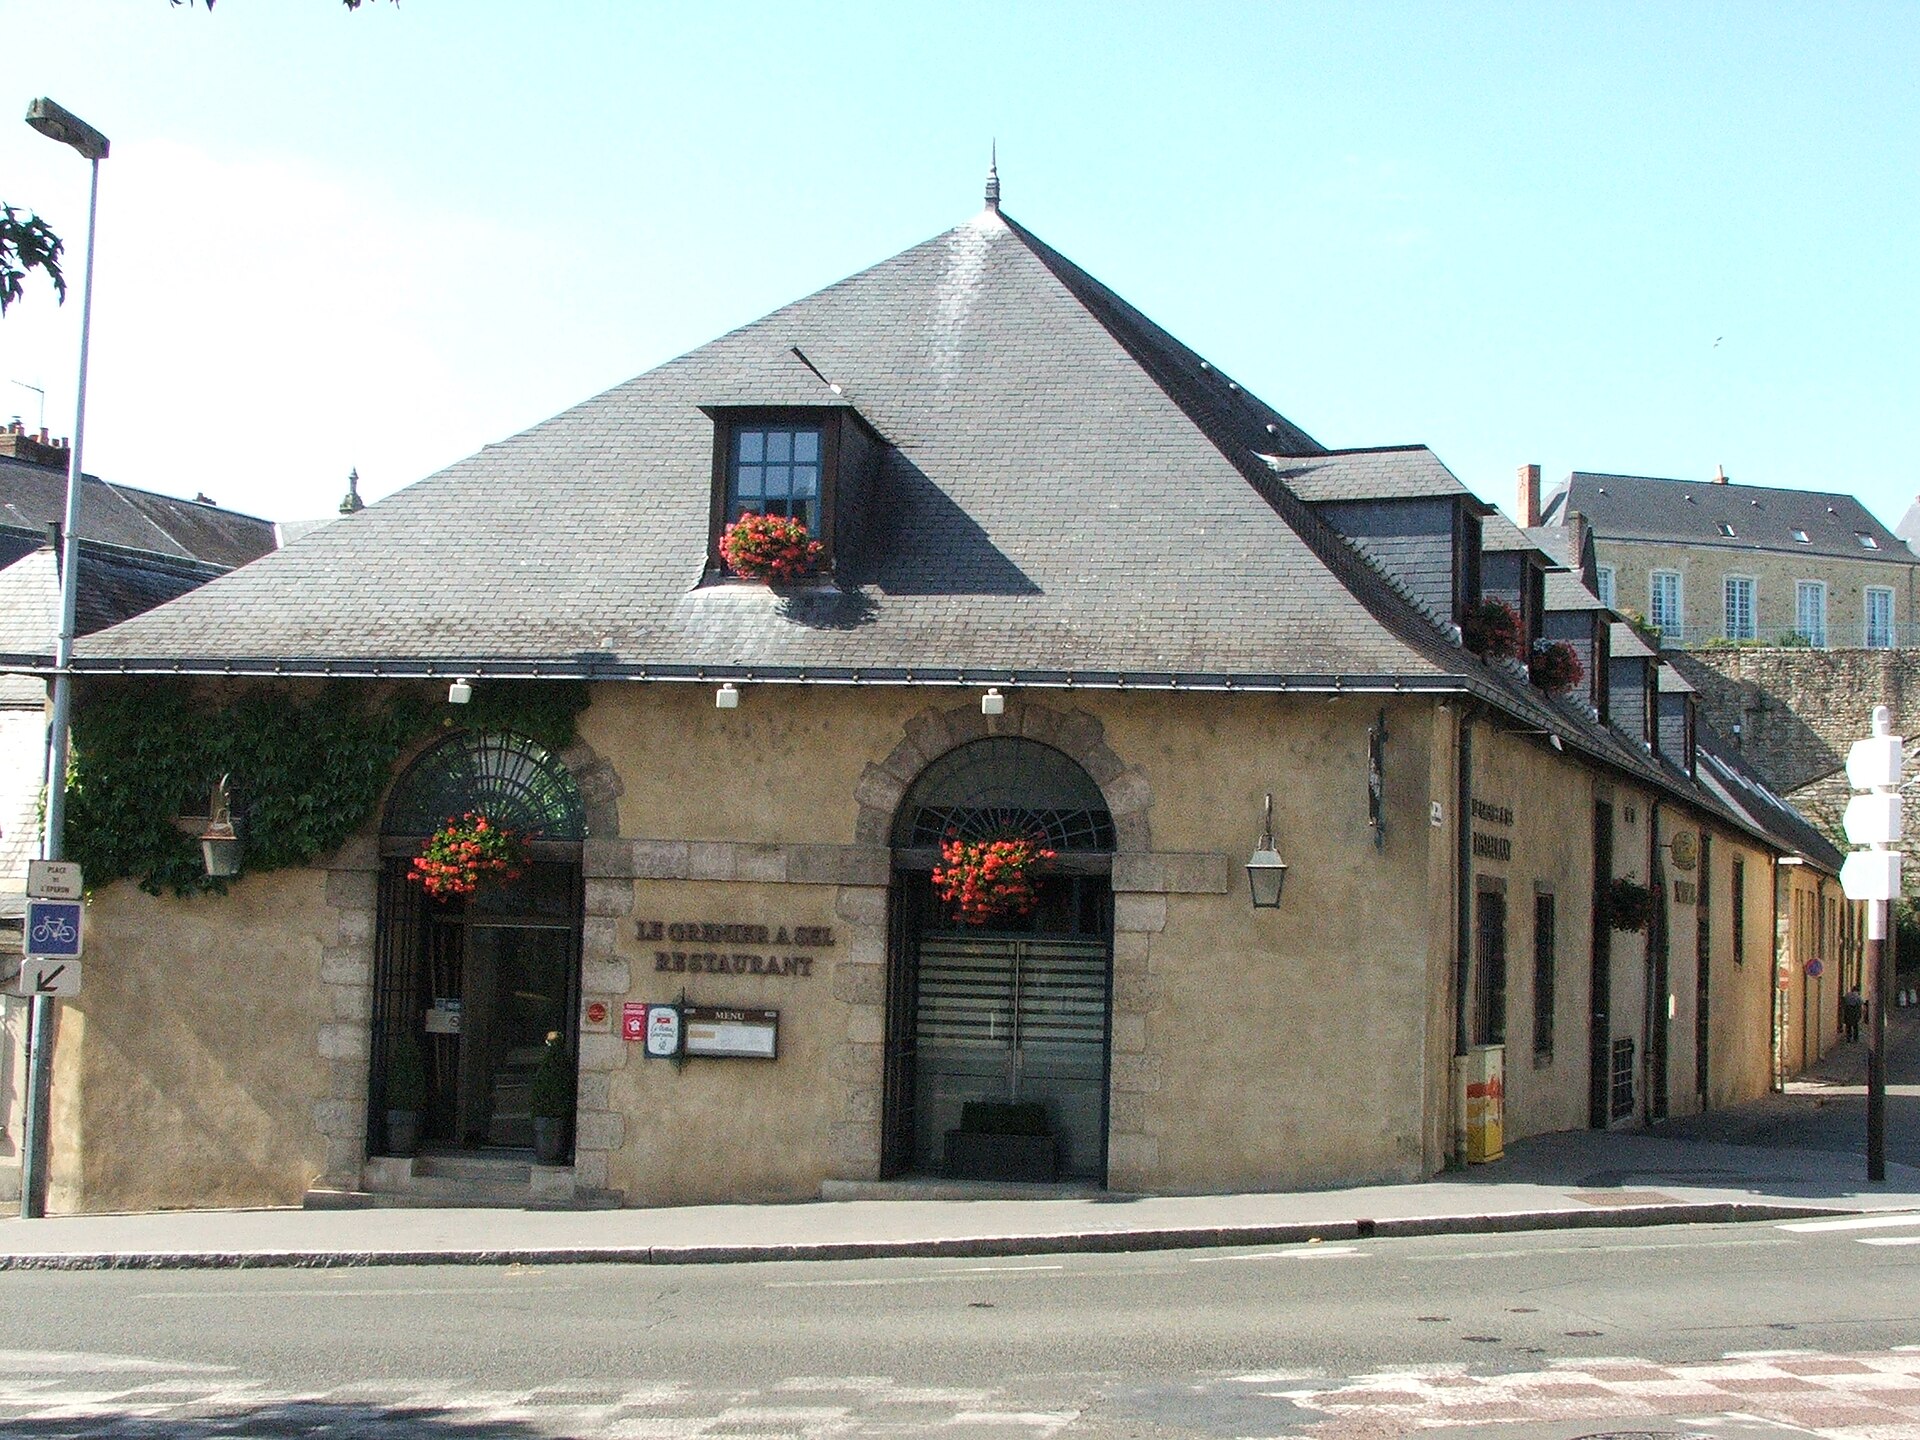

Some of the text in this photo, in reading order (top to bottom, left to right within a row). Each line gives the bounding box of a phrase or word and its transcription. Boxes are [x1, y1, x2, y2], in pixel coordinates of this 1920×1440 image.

[635, 920, 664, 941] LE
[668, 922, 769, 944] GRENIER
[794, 926, 835, 946] SEL
[654, 951, 813, 977] RESTAURANT
[715, 1011, 745, 1020] MENU
